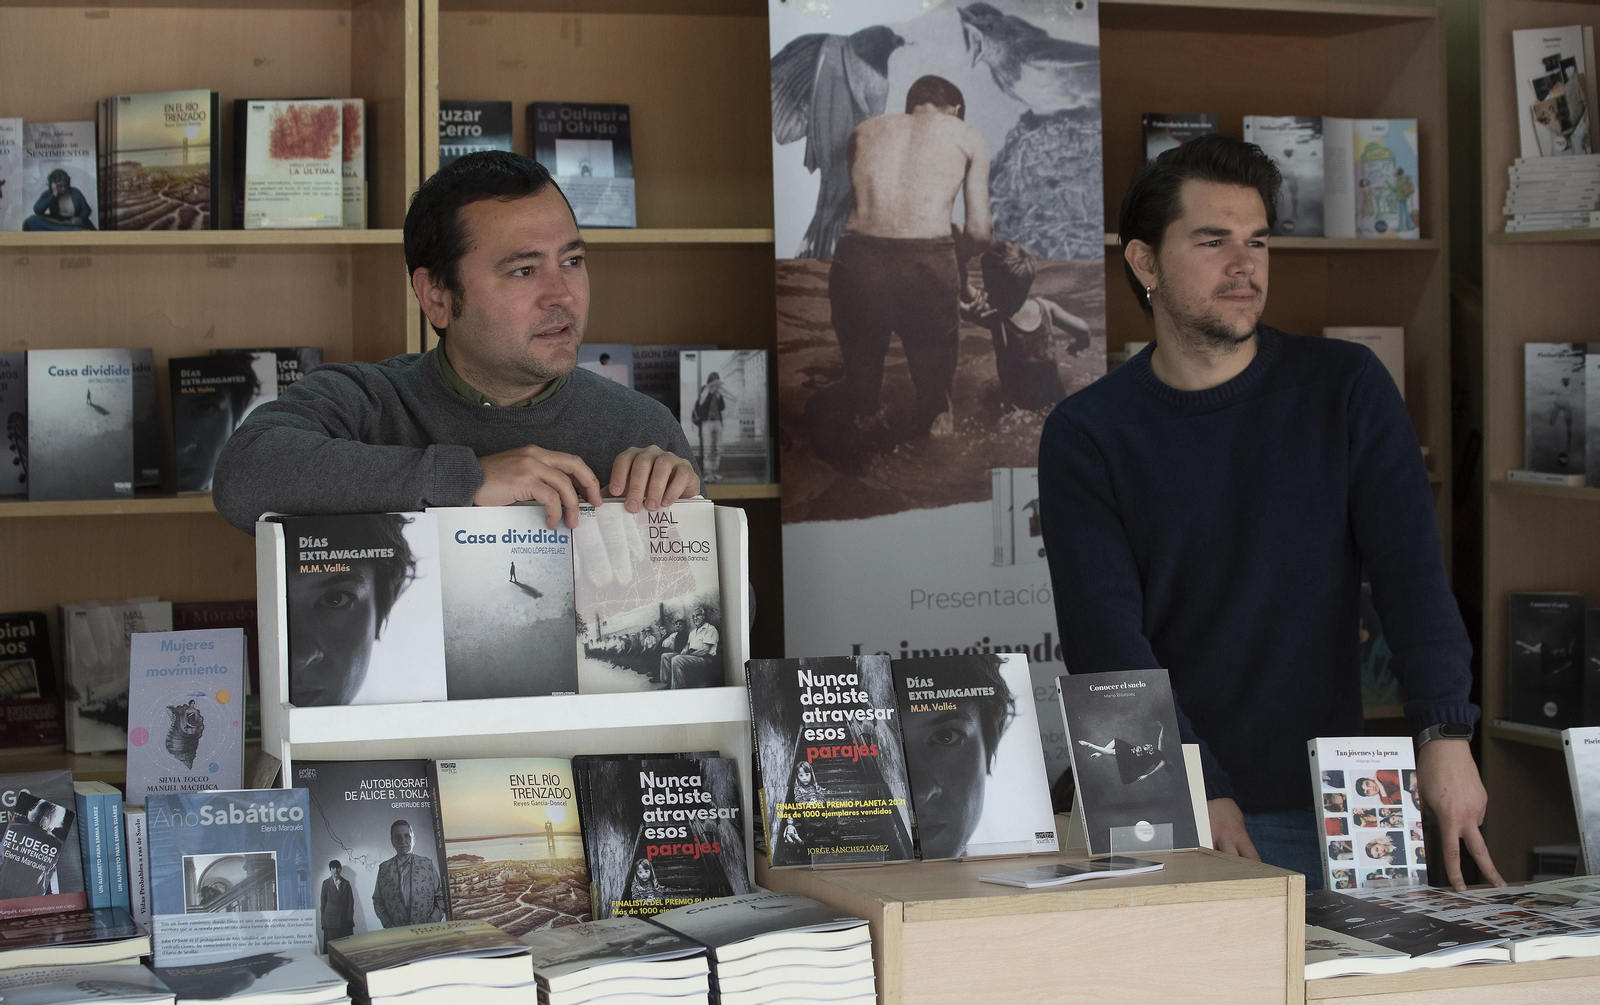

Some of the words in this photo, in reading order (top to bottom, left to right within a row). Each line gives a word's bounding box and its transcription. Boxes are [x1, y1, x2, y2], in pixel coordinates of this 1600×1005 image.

[164, 104, 174, 112] EN
[176, 102, 184, 111] EL
[164, 110, 206, 122] TRENZADO
[48, 365, 78, 377] Casa
[81, 364, 130, 376] dividida
[180, 368, 201, 378] DÍAS
[180, 376, 246, 386] EXTRAVAGANTES
[648, 512, 678, 524] MAL
[454, 530, 497, 544] Casa
[501, 528, 568, 544] dividida
[648, 526, 669, 539] DE
[298, 536, 328, 549] DÍAS
[650, 540, 710, 554] MUCHOS
[299, 548, 394, 562] EXTRAVAGANTES
[511, 546, 532, 554] ANTONIO
[688, 554, 708, 562] Sánchez
[300, 564, 323, 574] M.M.
[324, 563, 350, 572] Vallés
[160, 638, 214, 653] Mujeres
[179, 652, 195, 664] en
[146, 664, 228, 678] movimiento
[798, 670, 858, 688] Nunca
[906, 676, 934, 688] DÍAS
[1089, 683, 1120, 692] Conocer
[1128, 680, 1146, 688] suelo
[800, 686, 868, 706] debiste
[908, 686, 995, 700] EXTRAVAGANTES
[910, 704, 932, 712] M.M.
[932, 702, 958, 712] Vallés
[802, 707, 894, 724] atravesar
[804, 726, 846, 742] esos
[806, 739, 879, 764] parajes
[1348, 749, 1371, 758] jóvenes
[158, 776, 181, 784] SILVIA
[510, 774, 526, 786] EN
[528, 774, 540, 786] EL
[542, 772, 560, 786] RÍO
[639, 771, 702, 789] Nunca
[146, 784, 178, 792] MANUEL
[180, 784, 218, 792] MACHUCA
[510, 787, 572, 800] TRENZADO
[344, 792, 358, 801] DE
[359, 790, 386, 801] ALICE
[389, 790, 398, 800] B.
[400, 789, 430, 799] TOKLA
[641, 788, 712, 806] debiste
[776, 802, 812, 810] FINALISTA
[812, 801, 825, 810] DEL
[826, 800, 854, 808] PREMIO
[854, 799, 887, 808] PLANETA
[888, 798, 906, 806] 2021
[642, 806, 740, 822] atravesar
[776, 810, 791, 818] Más
[792, 810, 802, 818] de
[802, 810, 820, 818] 1000
[822, 809, 860, 819] ejemplares
[860, 808, 892, 816] vendidos
[278, 824, 304, 834] Marqués
[644, 826, 688, 840] esos
[4, 830, 18, 844] EL
[19, 836, 58, 858] JUEGO
[12, 844, 19, 852] LA
[136, 838, 142, 846] de
[4, 850, 20, 862] Elena
[646, 838, 722, 862] parajes
[807, 846, 830, 856] JORGE
[830, 844, 864, 854] SÁNCHEZ
[865, 844, 889, 852] LÓPEZ
[137, 864, 145, 895] Probables
[98, 884, 104, 894] UN
[117, 884, 123, 892] UN
[612, 898, 648, 907] FINALISTA
[650, 898, 664, 906] DEL
[665, 897, 694, 906] PREMIO
